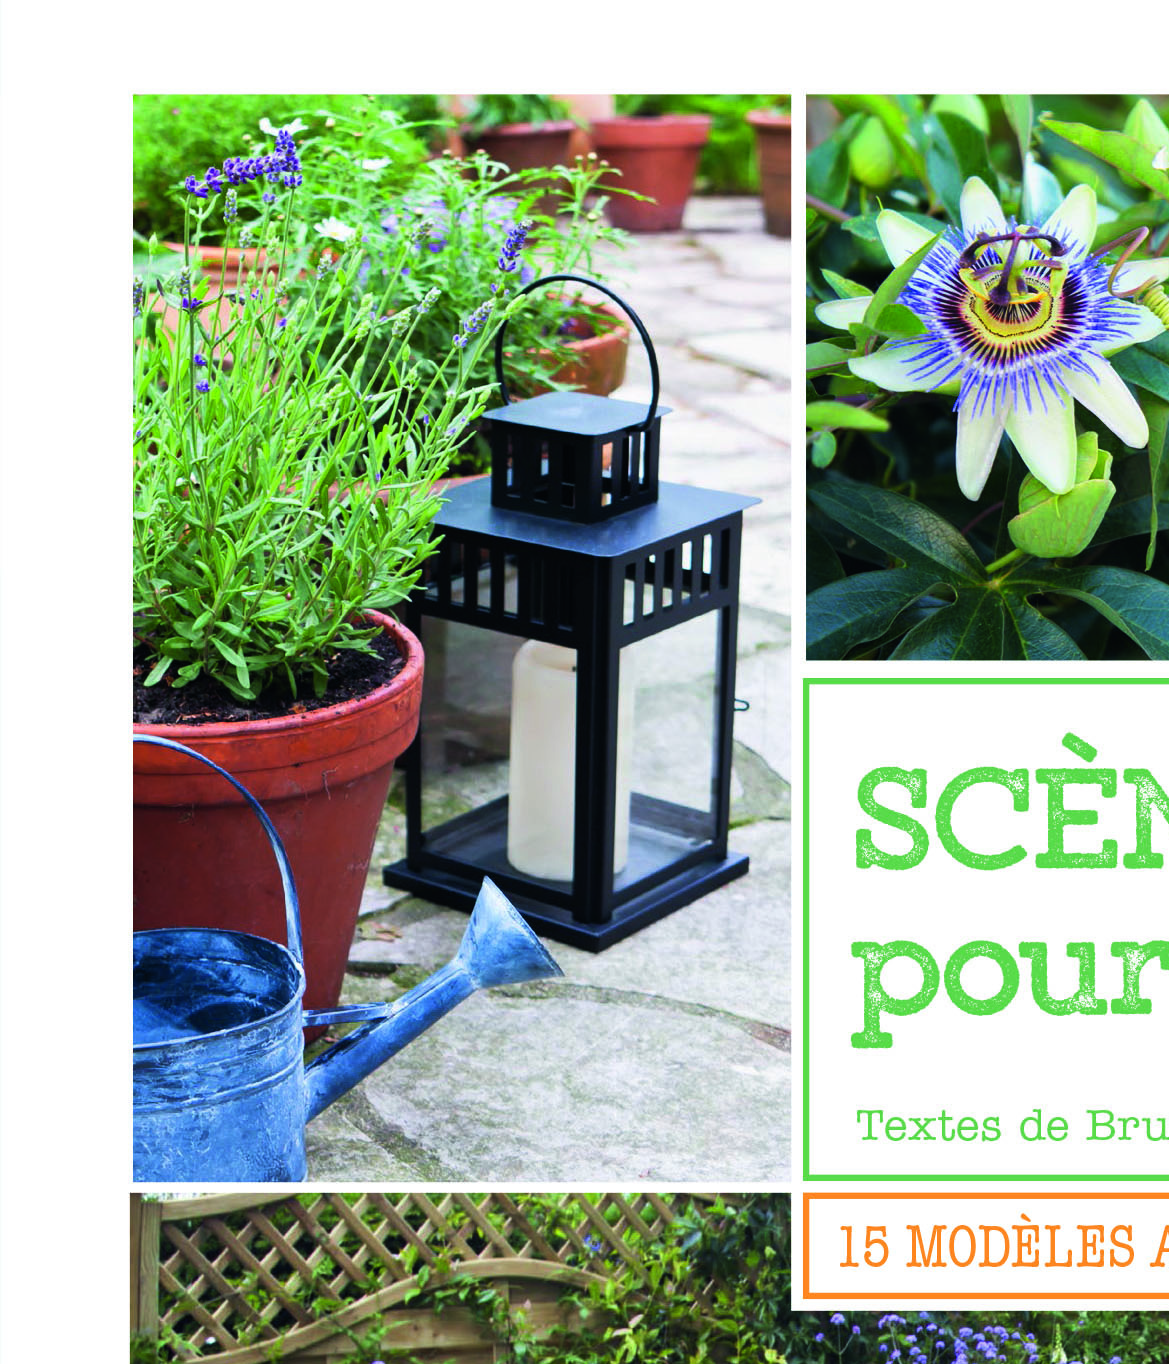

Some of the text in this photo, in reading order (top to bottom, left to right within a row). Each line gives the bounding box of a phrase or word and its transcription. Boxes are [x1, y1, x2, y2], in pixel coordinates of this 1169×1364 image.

[857, 1108, 1002, 1143] Textes
[1020, 1107, 1069, 1142] de
[840, 1224, 889, 1269] 15
[906, 1213, 1135, 1269] MODÈLES
